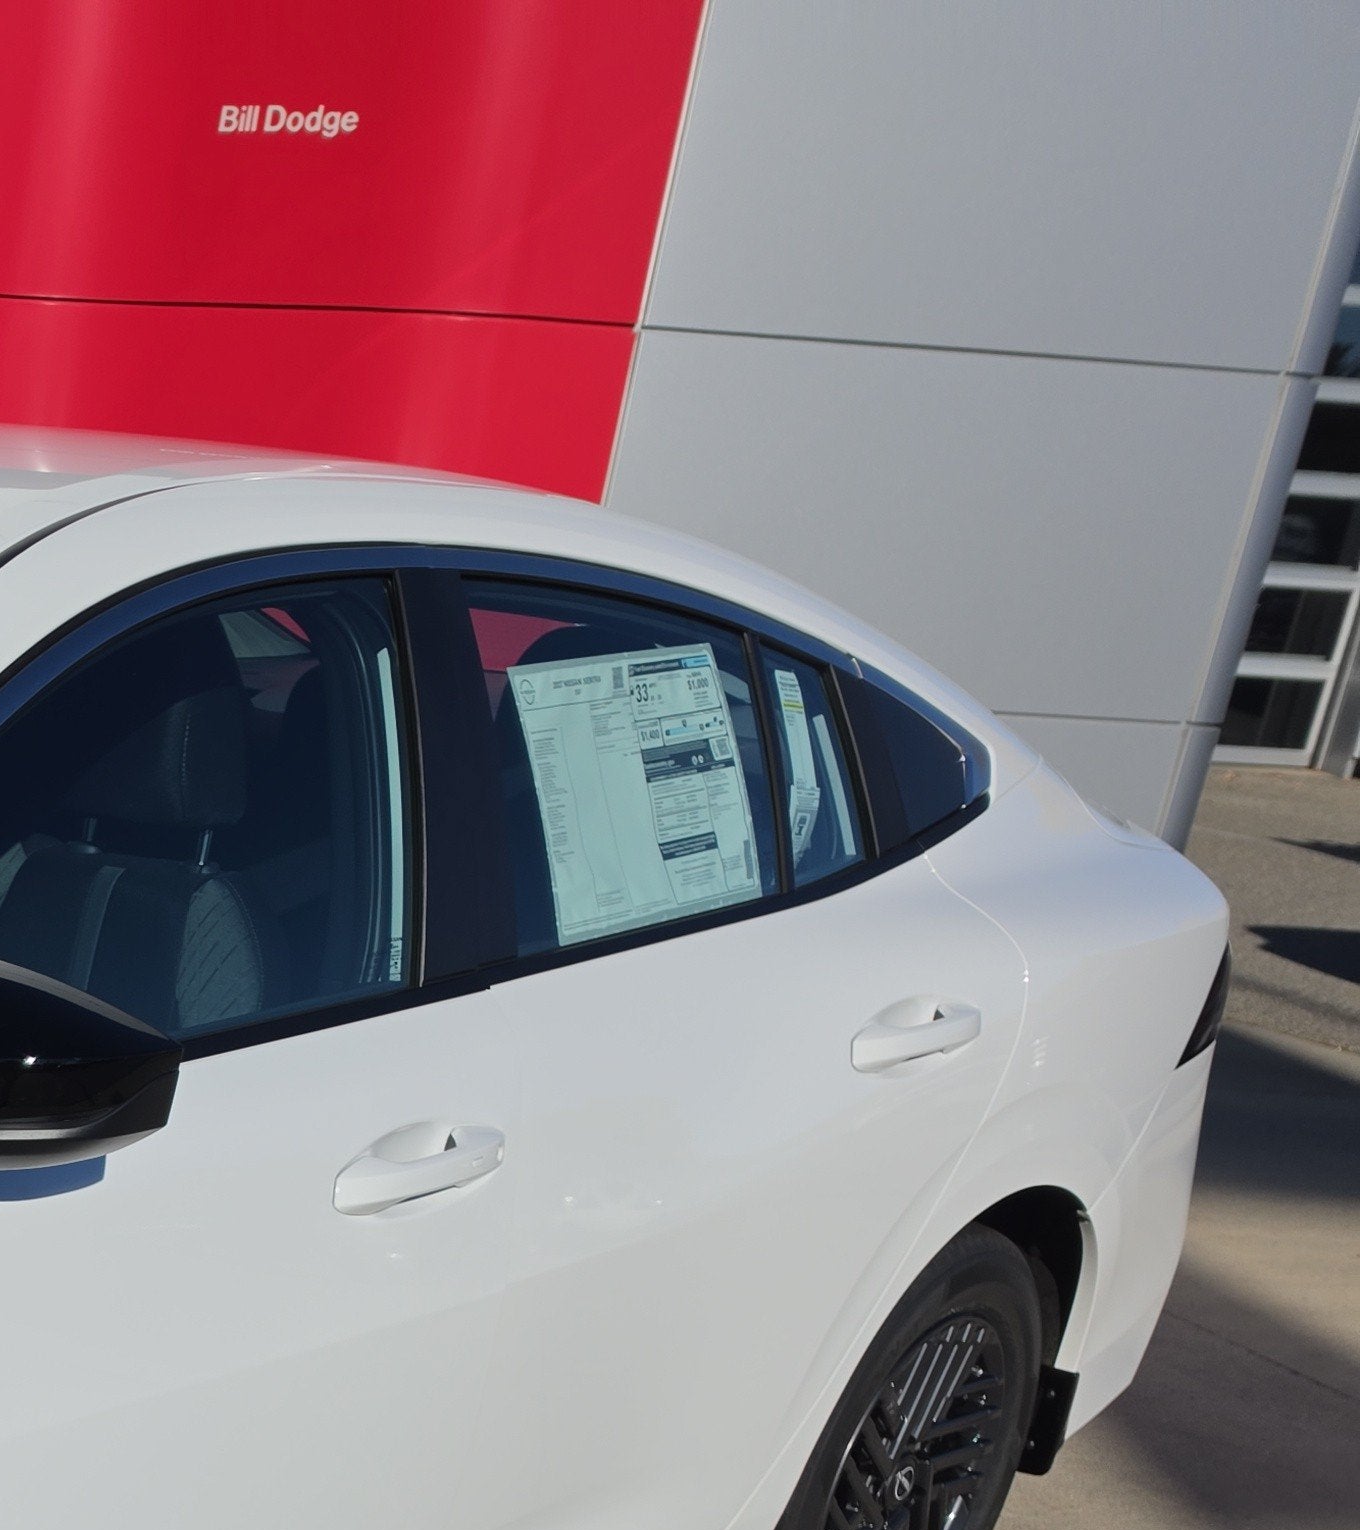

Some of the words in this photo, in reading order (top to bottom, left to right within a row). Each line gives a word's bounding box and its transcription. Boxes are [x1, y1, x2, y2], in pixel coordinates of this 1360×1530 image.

[218, 105, 261, 133] Bill
[263, 104, 360, 138] Dodge
[635, 683, 649, 703] 33
